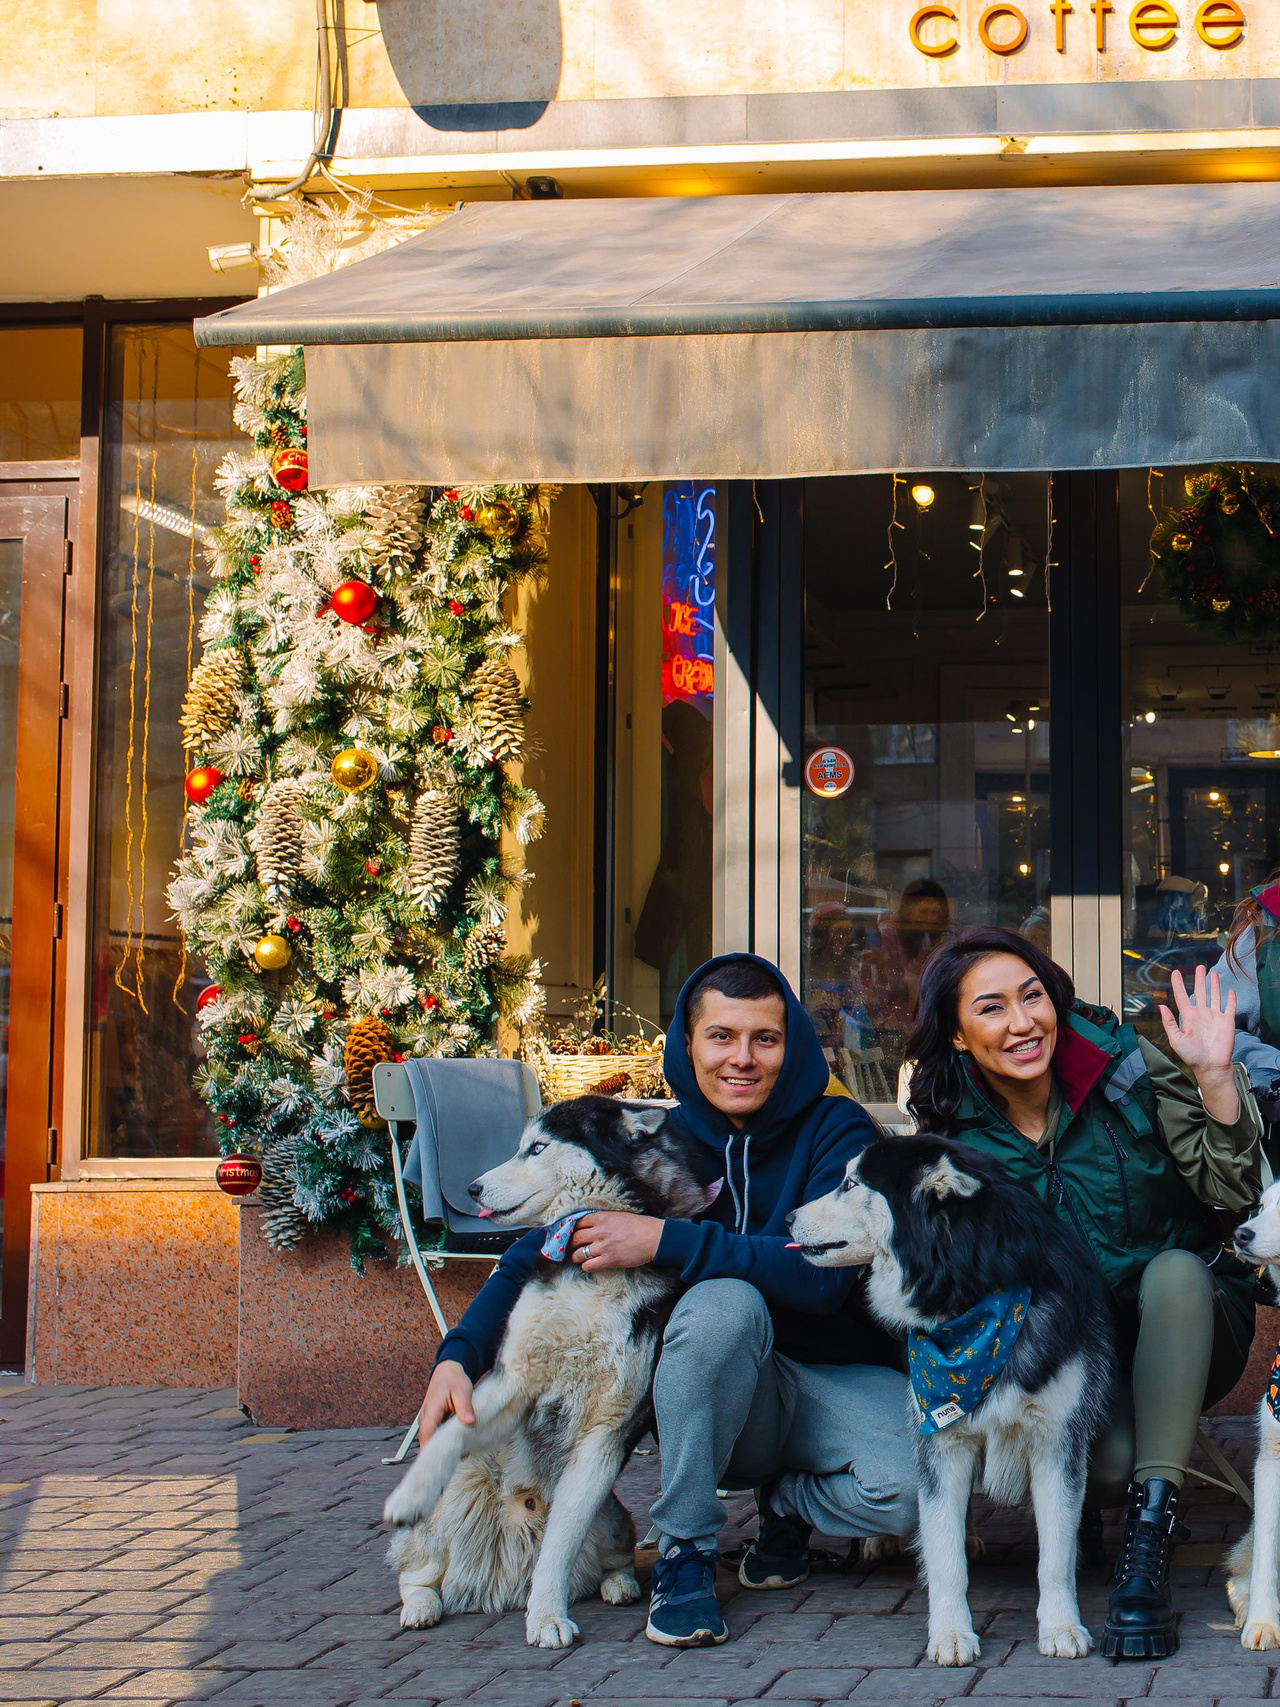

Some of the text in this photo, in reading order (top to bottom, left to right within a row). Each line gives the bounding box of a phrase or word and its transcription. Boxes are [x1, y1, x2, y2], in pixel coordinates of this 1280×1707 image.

[908, 0, 1246, 57] coffee
[288, 452, 307, 462] Chr
[669, 601, 699, 636] ICE
[817, 770, 843, 779] AEMS
[936, 1405, 957, 1419] nuna
